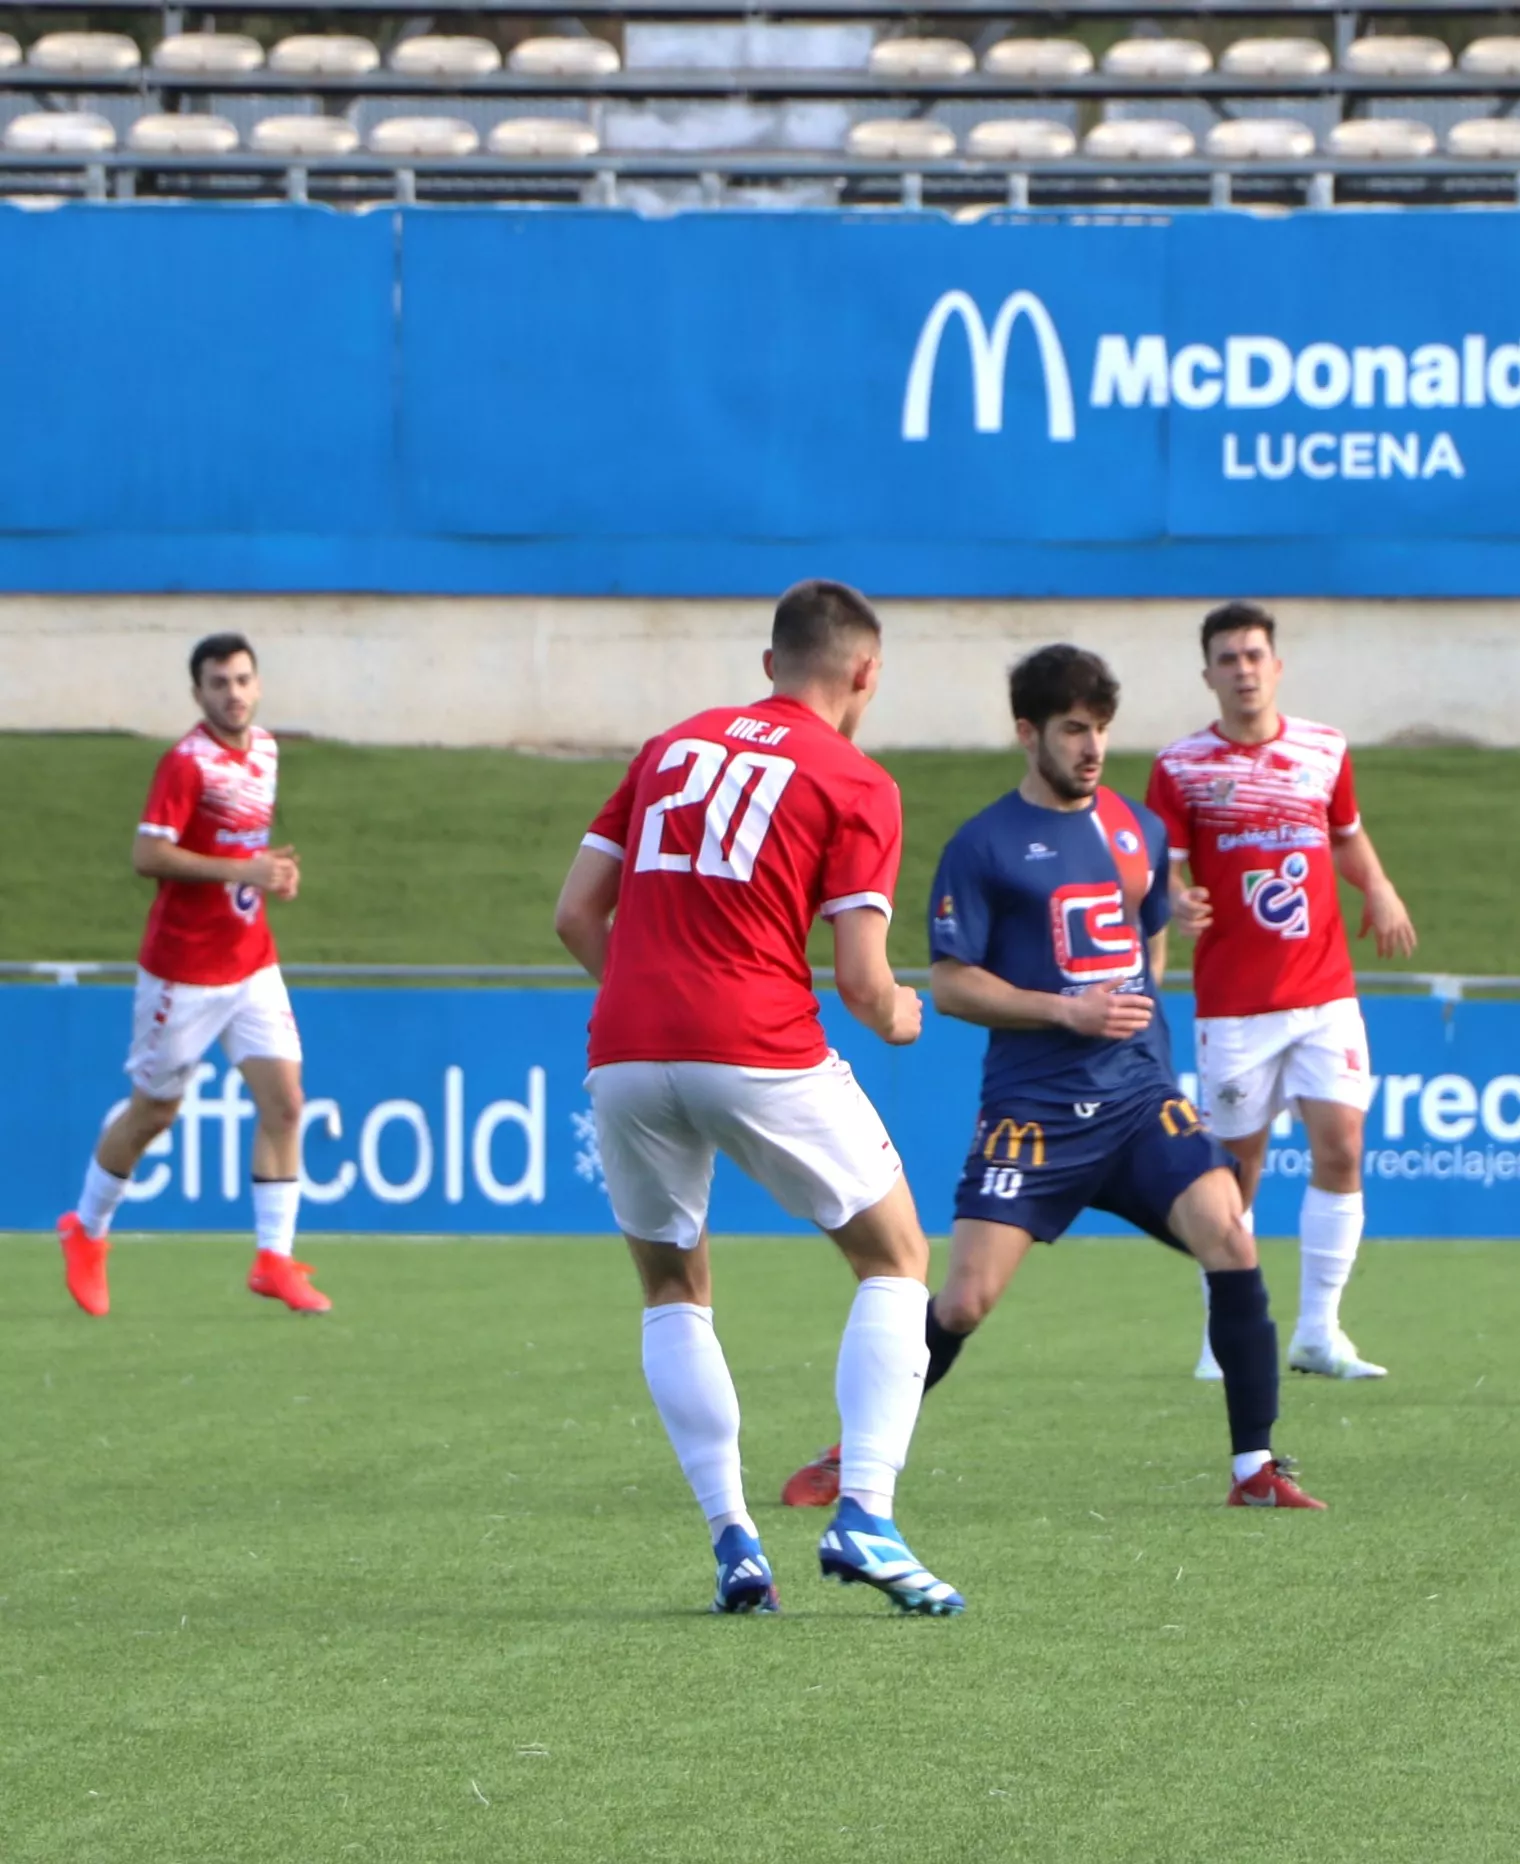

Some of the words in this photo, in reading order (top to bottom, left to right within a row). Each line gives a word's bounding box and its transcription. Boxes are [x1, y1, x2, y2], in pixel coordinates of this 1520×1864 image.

[1223, 432, 1465, 479] LUCENA
[724, 716, 791, 747] MEJI
[634, 737, 797, 883] 20
[980, 1166, 1023, 1199] 10
